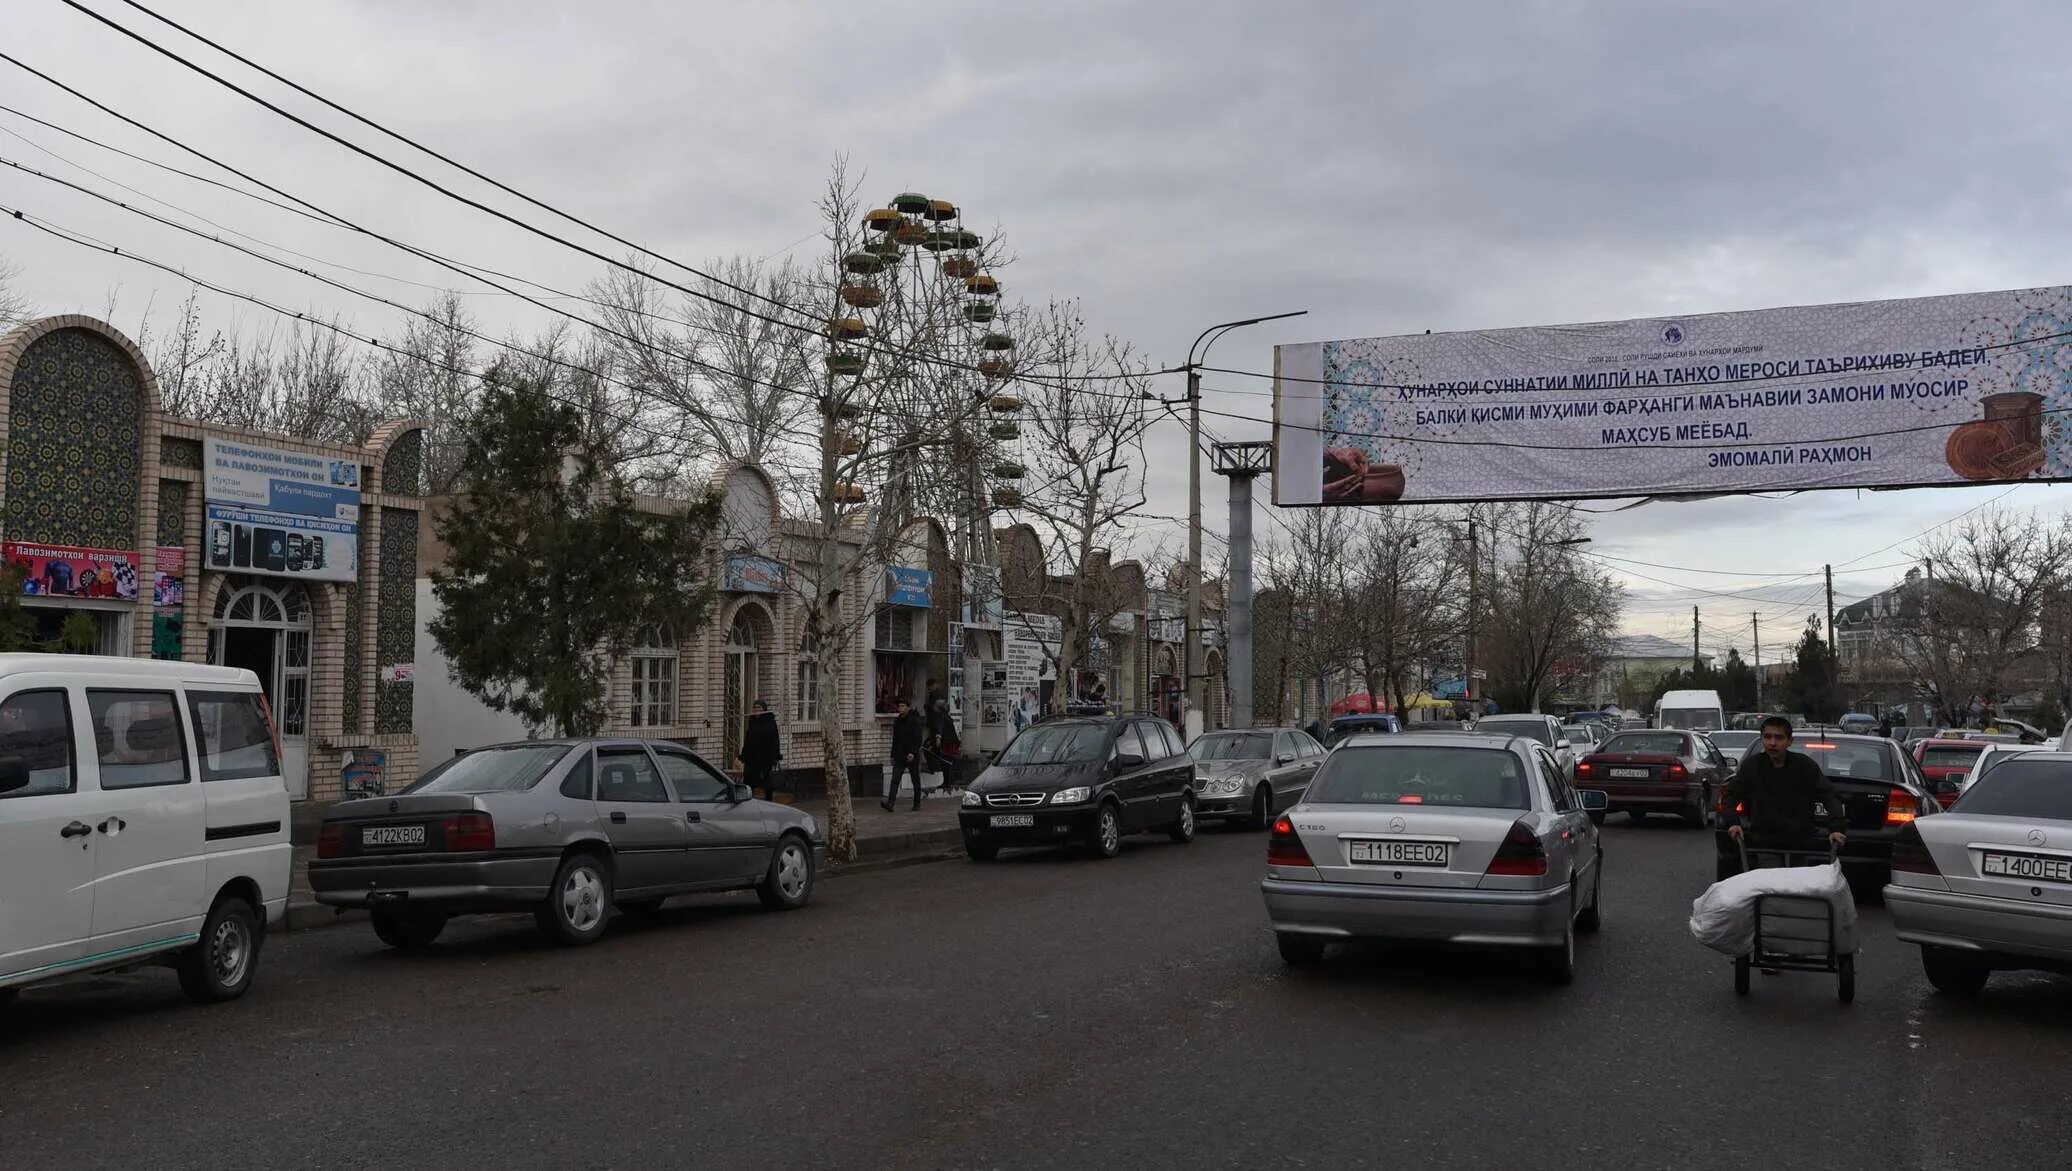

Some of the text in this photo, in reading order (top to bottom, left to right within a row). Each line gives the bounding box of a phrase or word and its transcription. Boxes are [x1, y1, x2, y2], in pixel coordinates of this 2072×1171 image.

[1398, 380, 1479, 402] ҲУНАРҲОИ
[1484, 375, 1568, 395] СУННАТИИ
[1573, 368, 1630, 390] МИЛЛӢ
[1636, 370, 1658, 386] НА
[1664, 365, 1720, 383] ТАНҲО
[1726, 359, 1800, 380] МЕРОСИ
[1805, 351, 1915, 374] ТАЪРИХИВУ
[1416, 379, 1969, 426] БАЛКИ ҚИСМИ МУҲИМИ ФАРҲАНГИ МАЪНАВИИ ЗАМОНИ МУОСИР
[1601, 420, 1753, 446] МАҲСУБ МЕЁБАД.
[1708, 446, 1872, 468] ЭМОМАЛӢ РАҲМОН
[215, 459, 229, 469] ВА
[311, 473, 324, 482] ОН
[372, 826, 424, 843] 4122KB02
[1367, 844, 1444, 862] 1118EE02
